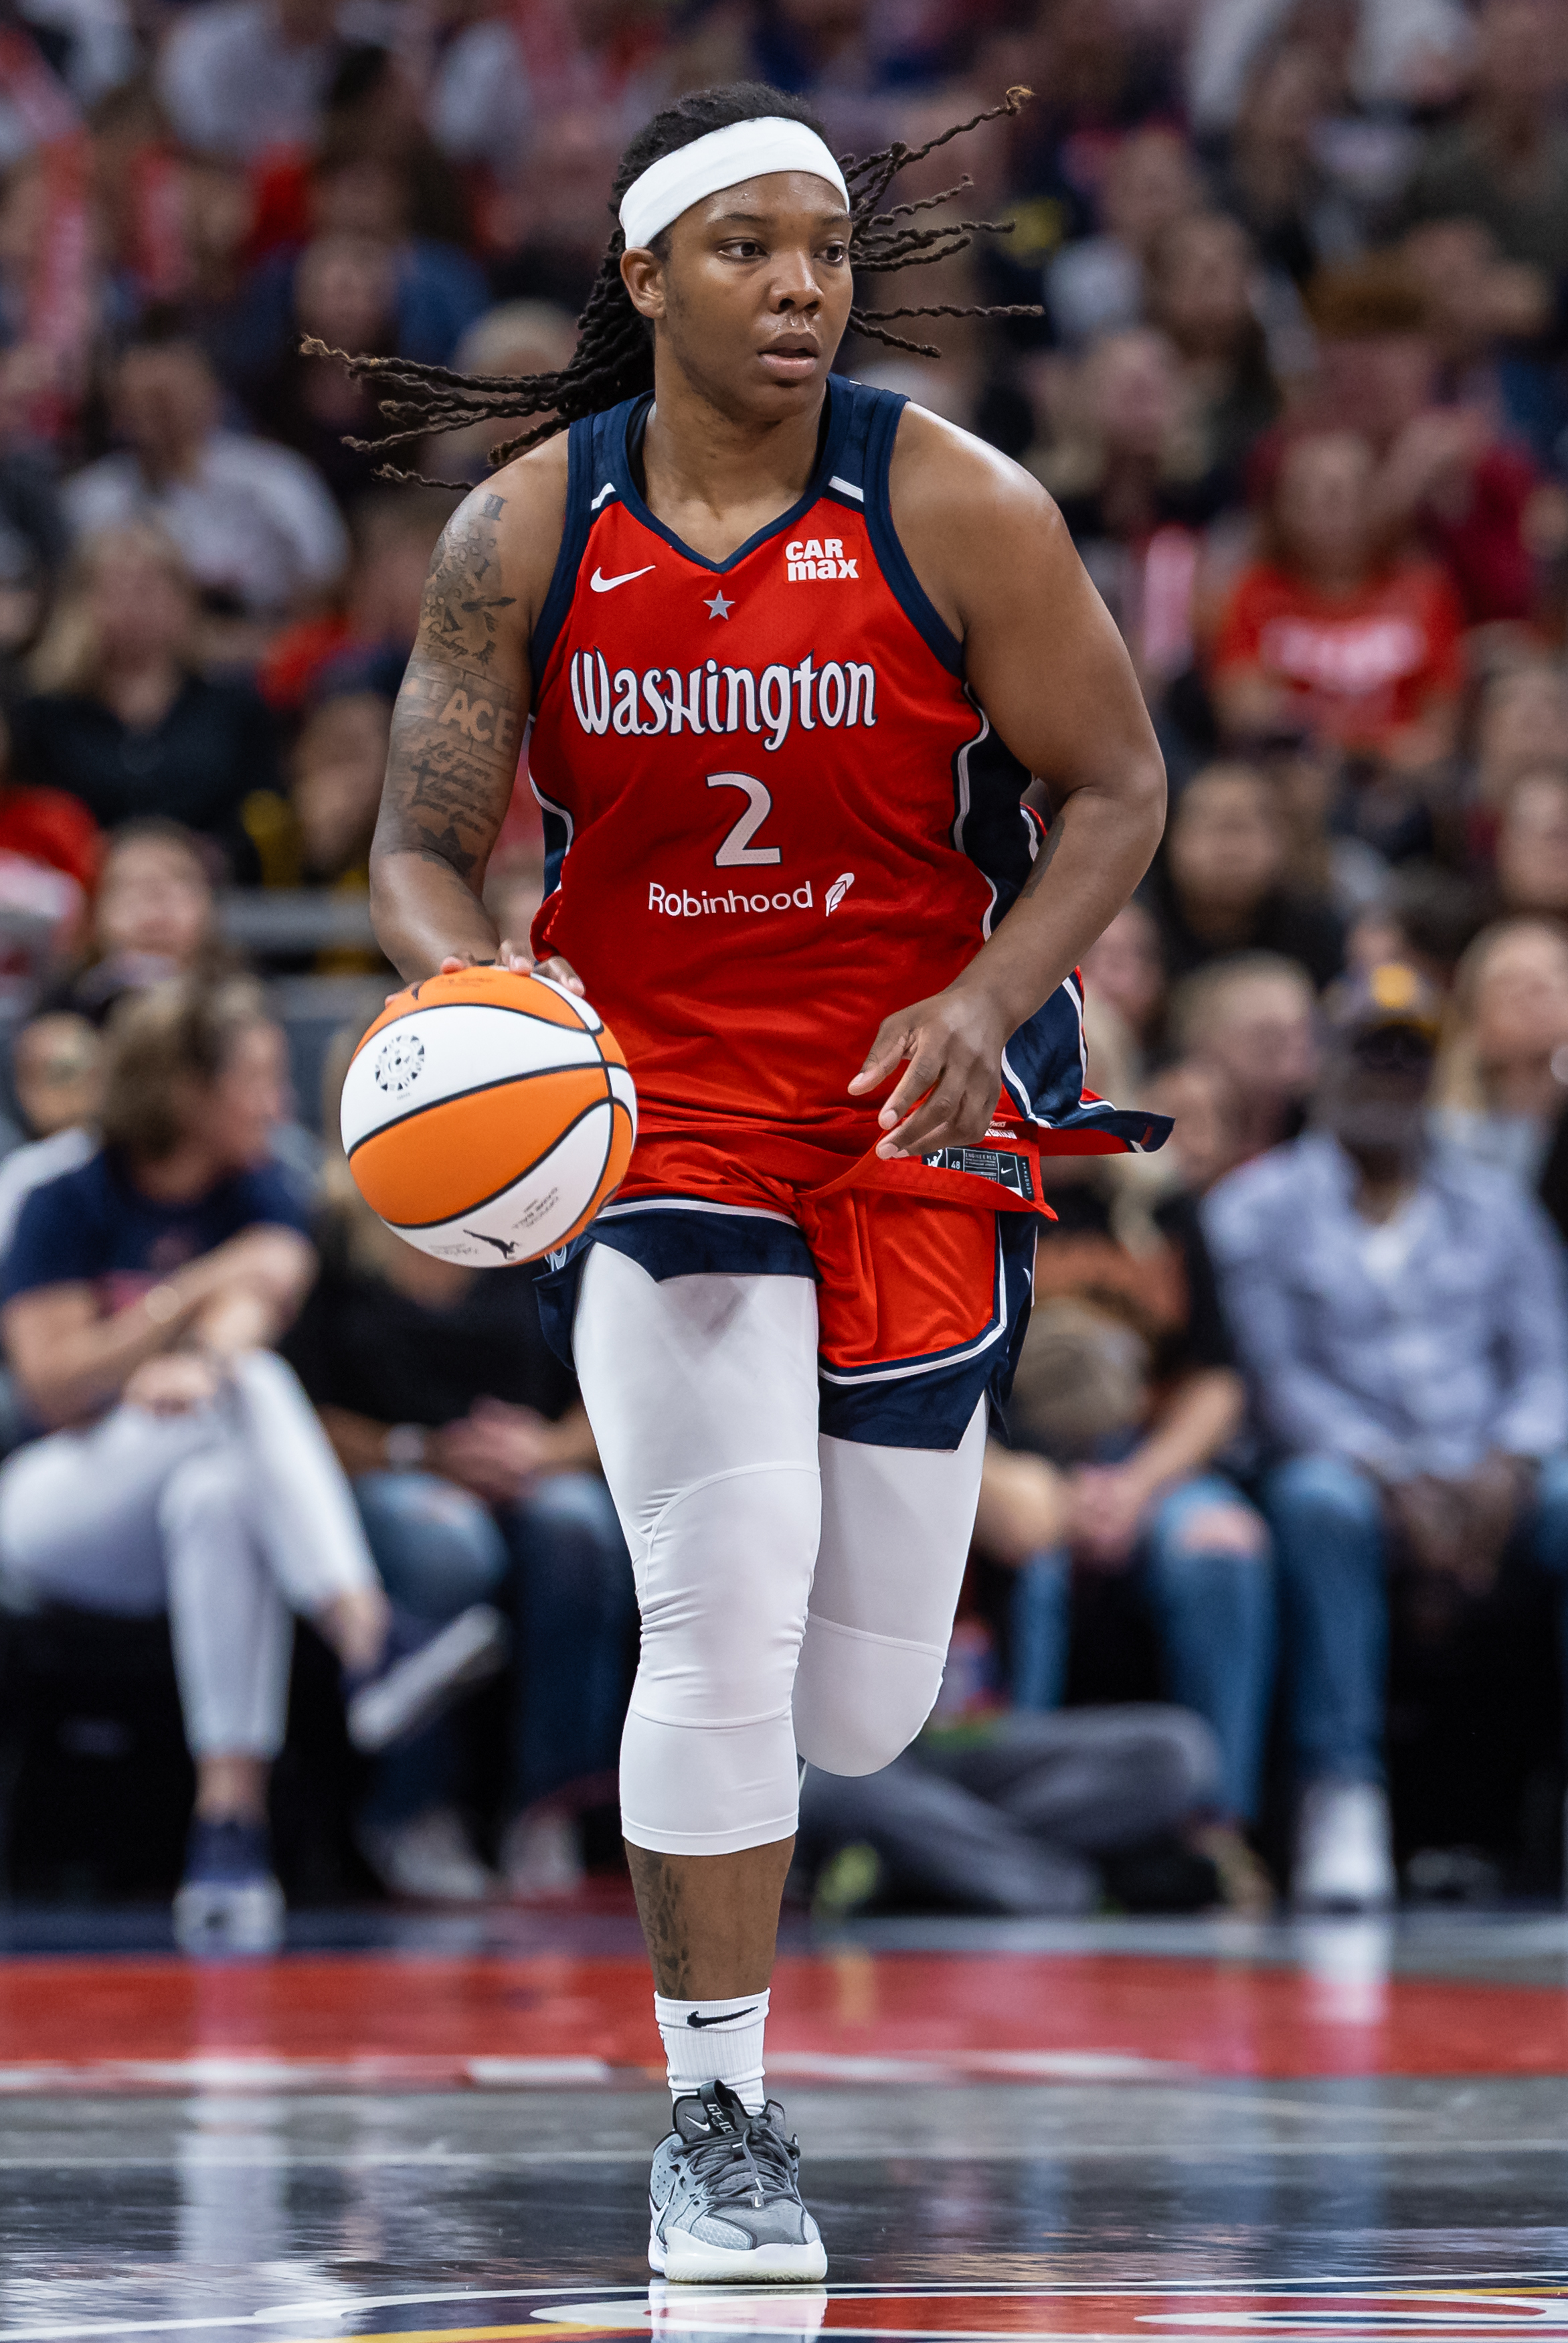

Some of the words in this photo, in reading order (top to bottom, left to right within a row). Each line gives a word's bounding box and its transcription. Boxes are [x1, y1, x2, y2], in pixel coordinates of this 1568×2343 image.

[785, 538, 843, 560] CAR
[788, 557, 859, 582] max
[570, 646, 877, 752] Washington
[438, 688, 519, 751] ACE
[705, 771, 781, 867] 2
[648, 880, 814, 917] Robinhood
[950, 1160, 960, 1169] 48
